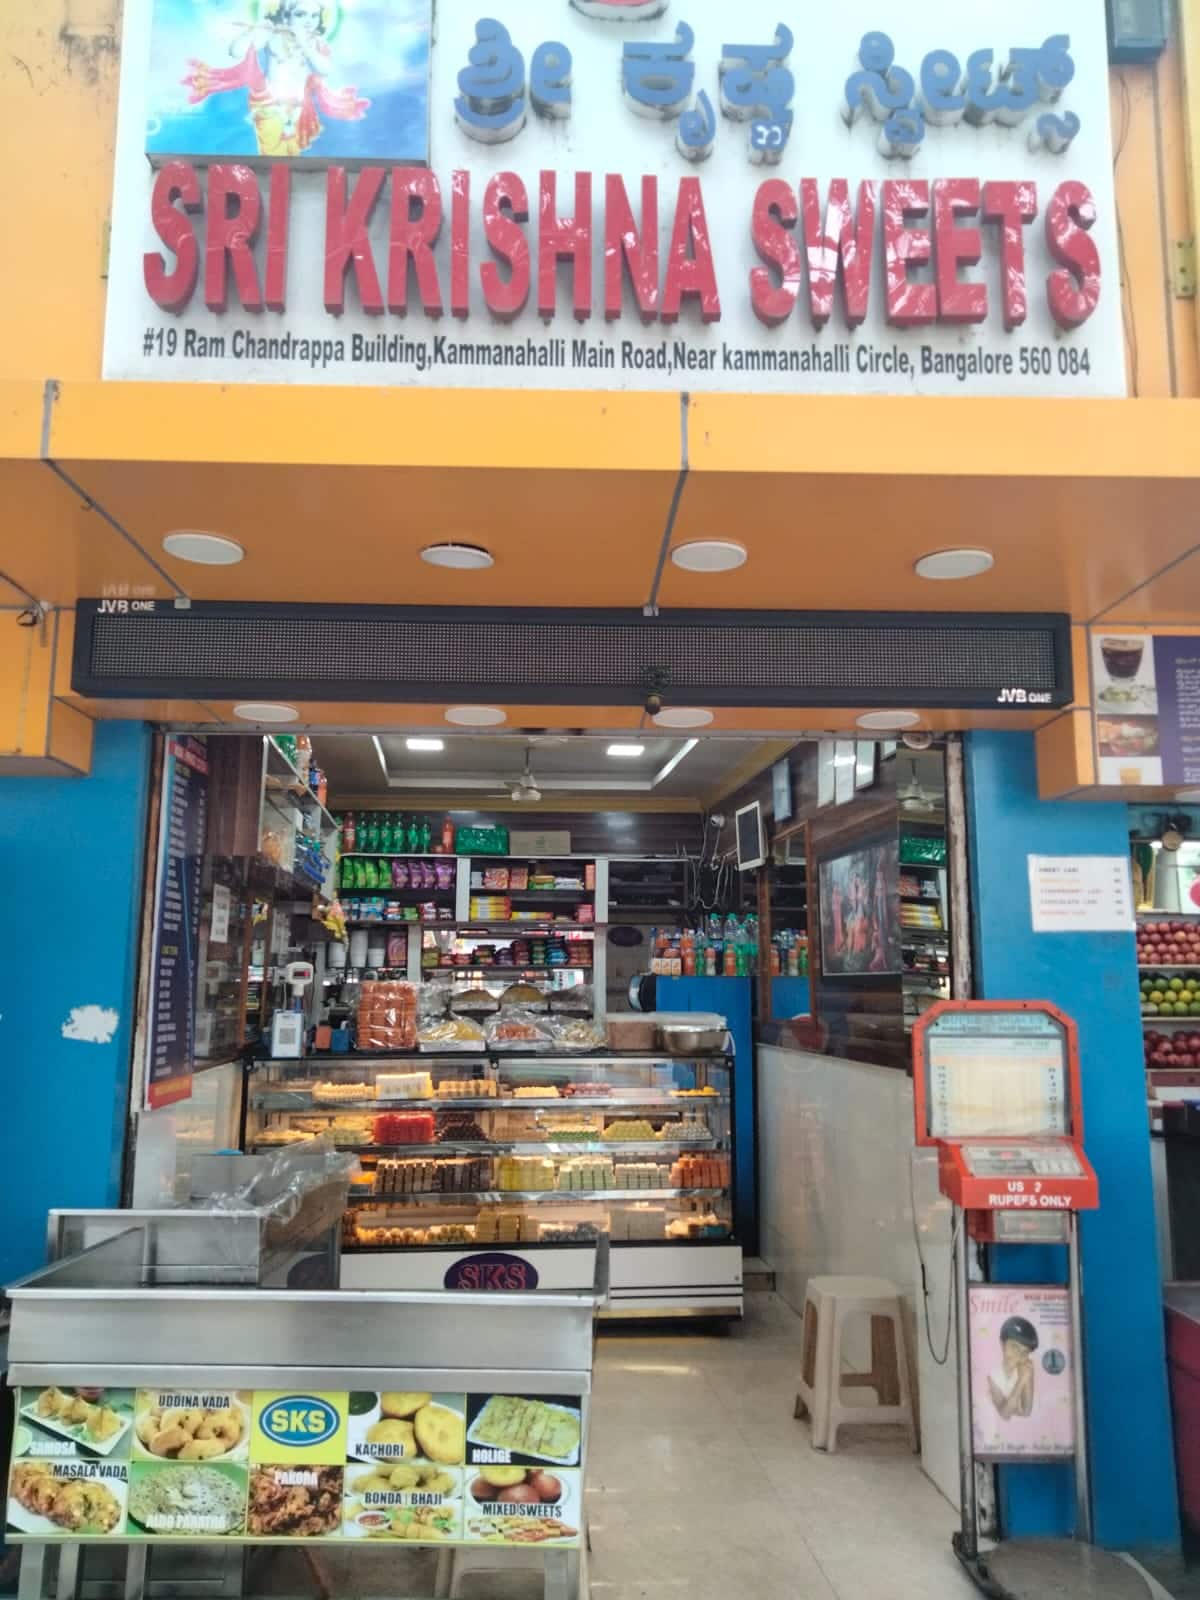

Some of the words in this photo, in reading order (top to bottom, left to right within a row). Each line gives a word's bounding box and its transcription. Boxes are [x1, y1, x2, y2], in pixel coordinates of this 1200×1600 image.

[454, 18, 572, 138] ಶ್ರೀ
[622, 20, 794, 158] ಕೃಷ್ಣ
[843, 31, 1080, 152] ಸ್ವೀಟ್ಸ್
[144, 161, 289, 312] SRI
[323, 165, 721, 322] KRISHNA
[750, 177, 1101, 326] SWEETS
[143, 328, 178, 356] #19
[184, 329, 226, 358] Ram
[231, 330, 345, 368] Chandrappa
[572, 340, 615, 368] Main
[722, 343, 850, 373] kammanahalli
[856, 345, 915, 378] Circle,
[921, 346, 1012, 381] Bangalore
[1019, 347, 1052, 375] 560
[1057, 348, 1090, 375] 084
[97, 600, 129, 613] JVB
[997, 688, 1027, 702] JVB
[1040, 1195, 1072, 1207] ONLY
[458, 1264, 527, 1289] SKS
[158, 1395, 199, 1408] UDDINA
[202, 1396, 230, 1408] VADA
[271, 1409, 326, 1433] SKS
[355, 1443, 404, 1457] KACHORI
[53, 1464, 97, 1478] MASALA
[100, 1465, 128, 1478] VADA
[364, 1492, 401, 1505] BONDA
[410, 1493, 443, 1506] BHAJI
[483, 1504, 517, 1516] MIXED
[519, 1504, 562, 1518] SWEETS
